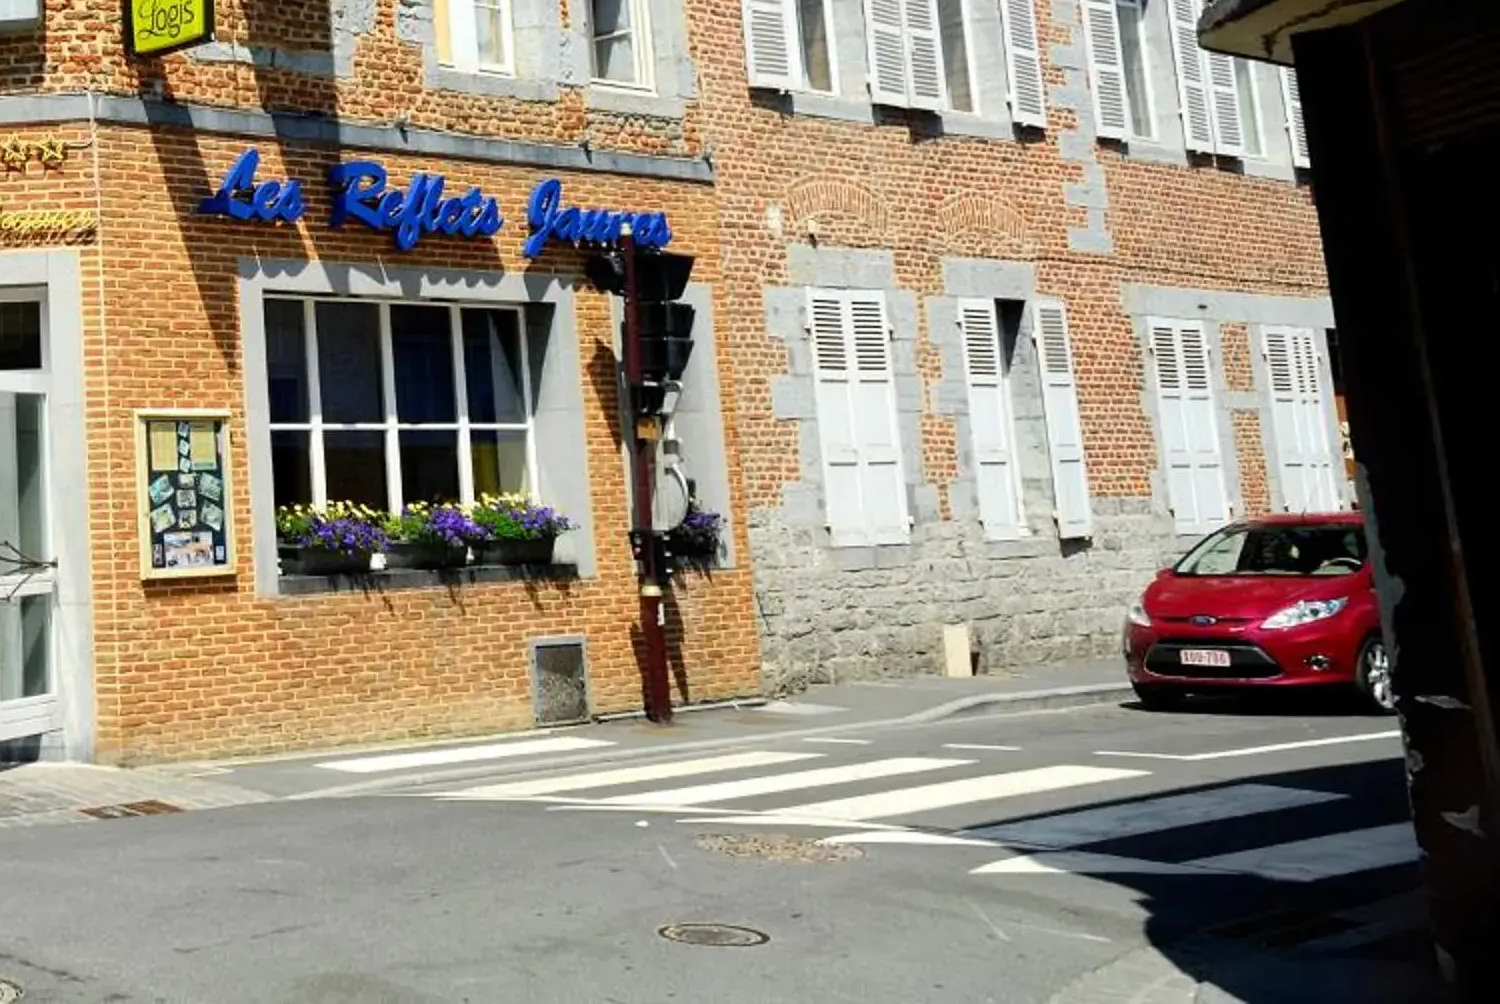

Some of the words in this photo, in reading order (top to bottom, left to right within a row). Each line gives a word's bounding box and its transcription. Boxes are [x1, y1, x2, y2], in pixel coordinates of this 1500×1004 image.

[197, 147, 305, 222] Les
[327, 159, 503, 252] Reflets
[521, 178, 673, 259] Jaunes
